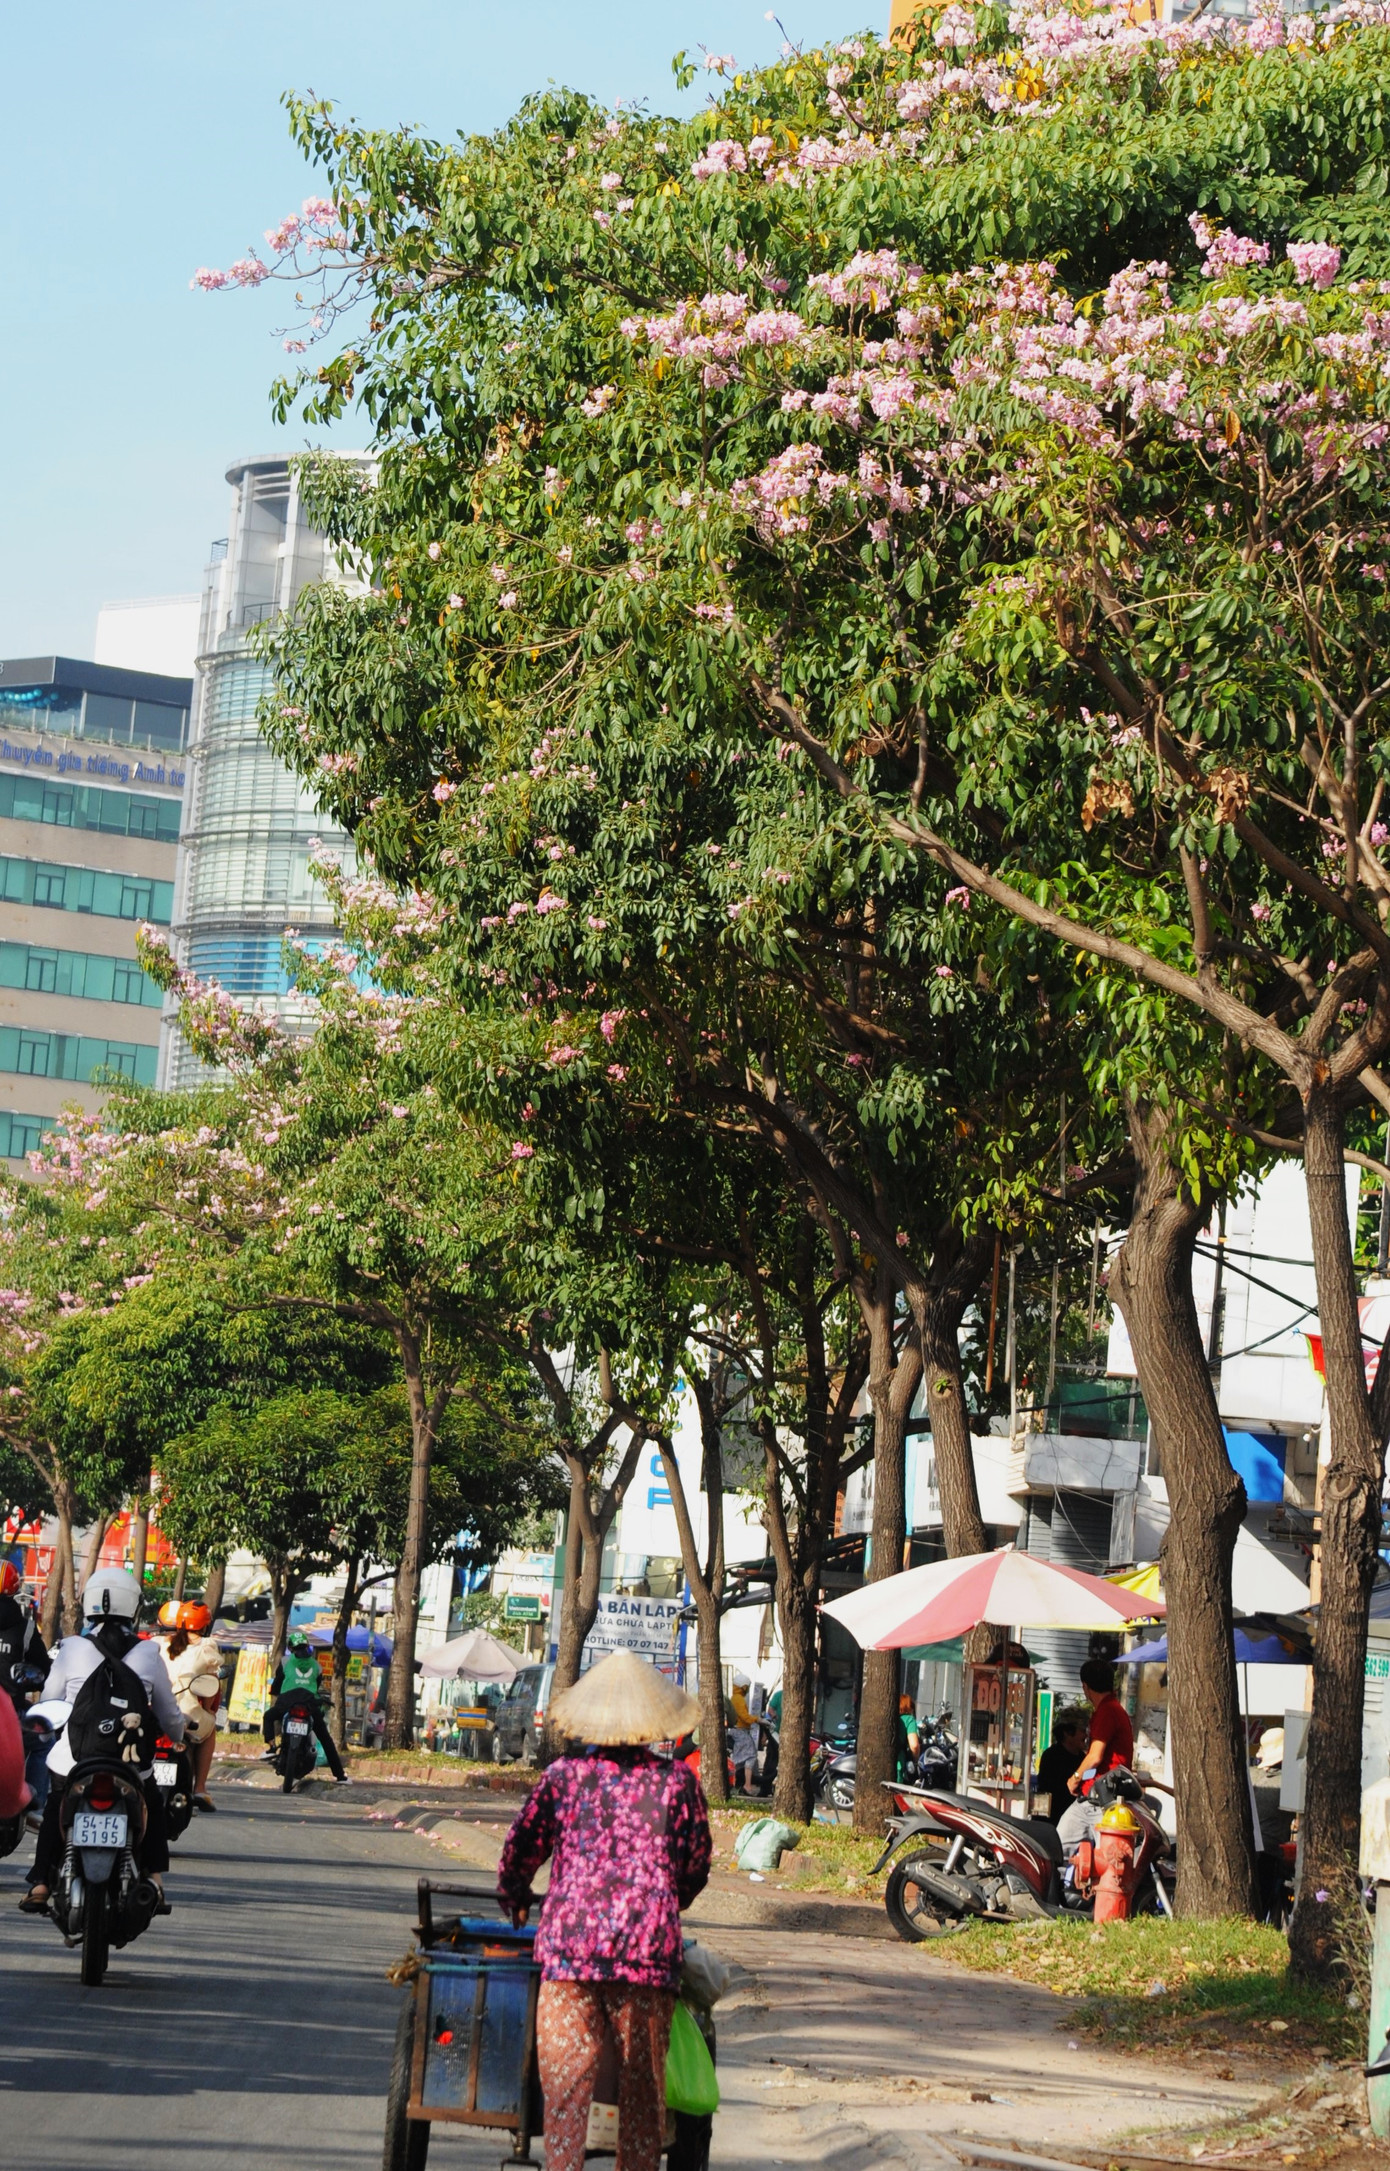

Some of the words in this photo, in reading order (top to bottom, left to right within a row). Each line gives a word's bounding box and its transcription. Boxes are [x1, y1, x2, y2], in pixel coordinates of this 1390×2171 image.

[0, 739, 53, 767] huyên
[57, 751, 82, 773] gia
[87, 753, 129, 783] tiếng
[134, 761, 165, 784] Anh
[608, 1598, 642, 1615] BÁN
[627, 1638, 637, 1648] 07
[640, 1640, 650, 1649] 07
[653, 1641, 669, 1650] 147
[83, 1815, 119, 1830] 54-F4
[81, 1830, 119, 1845] 5195
